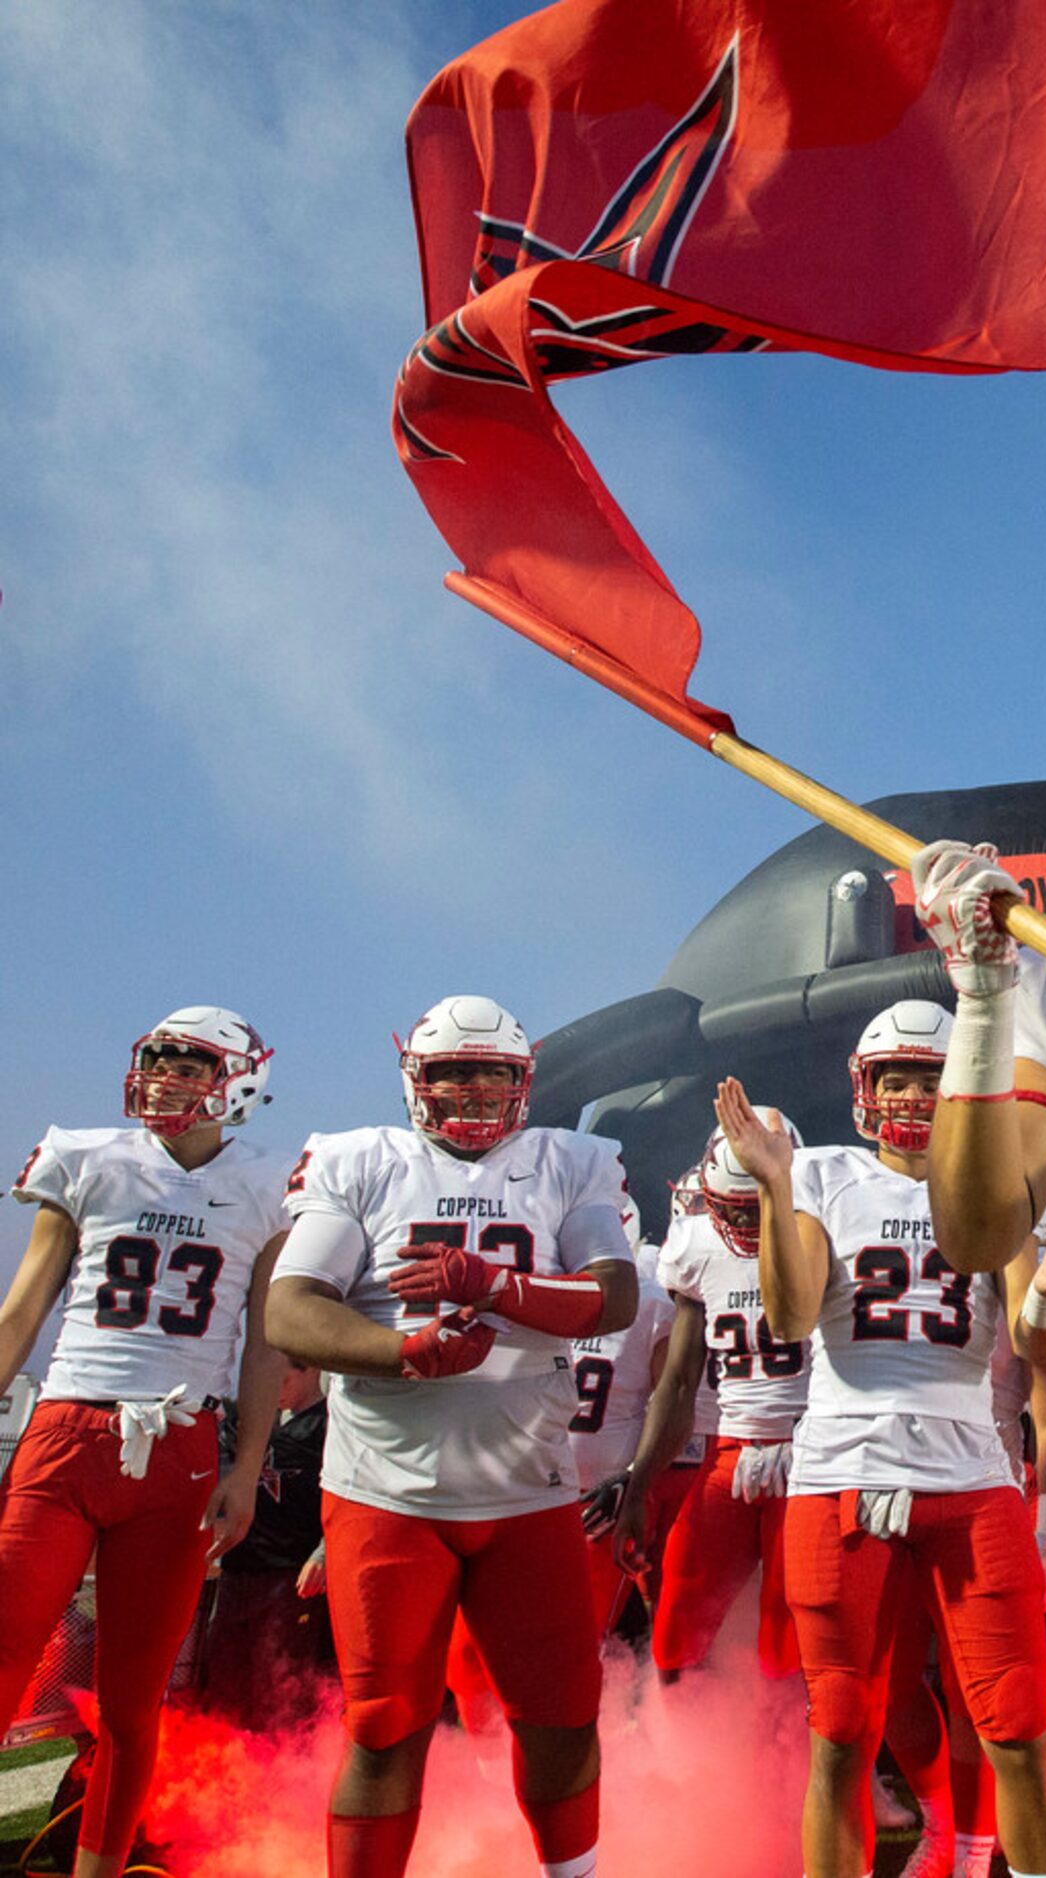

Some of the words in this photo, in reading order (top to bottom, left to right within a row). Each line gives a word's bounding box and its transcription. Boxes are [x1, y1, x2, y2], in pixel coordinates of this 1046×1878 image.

[136, 1211, 206, 1239] COPPELL
[437, 1196, 508, 1218] COPPELL
[94, 1235, 225, 1338] 83
[852, 1246, 973, 1349] 23
